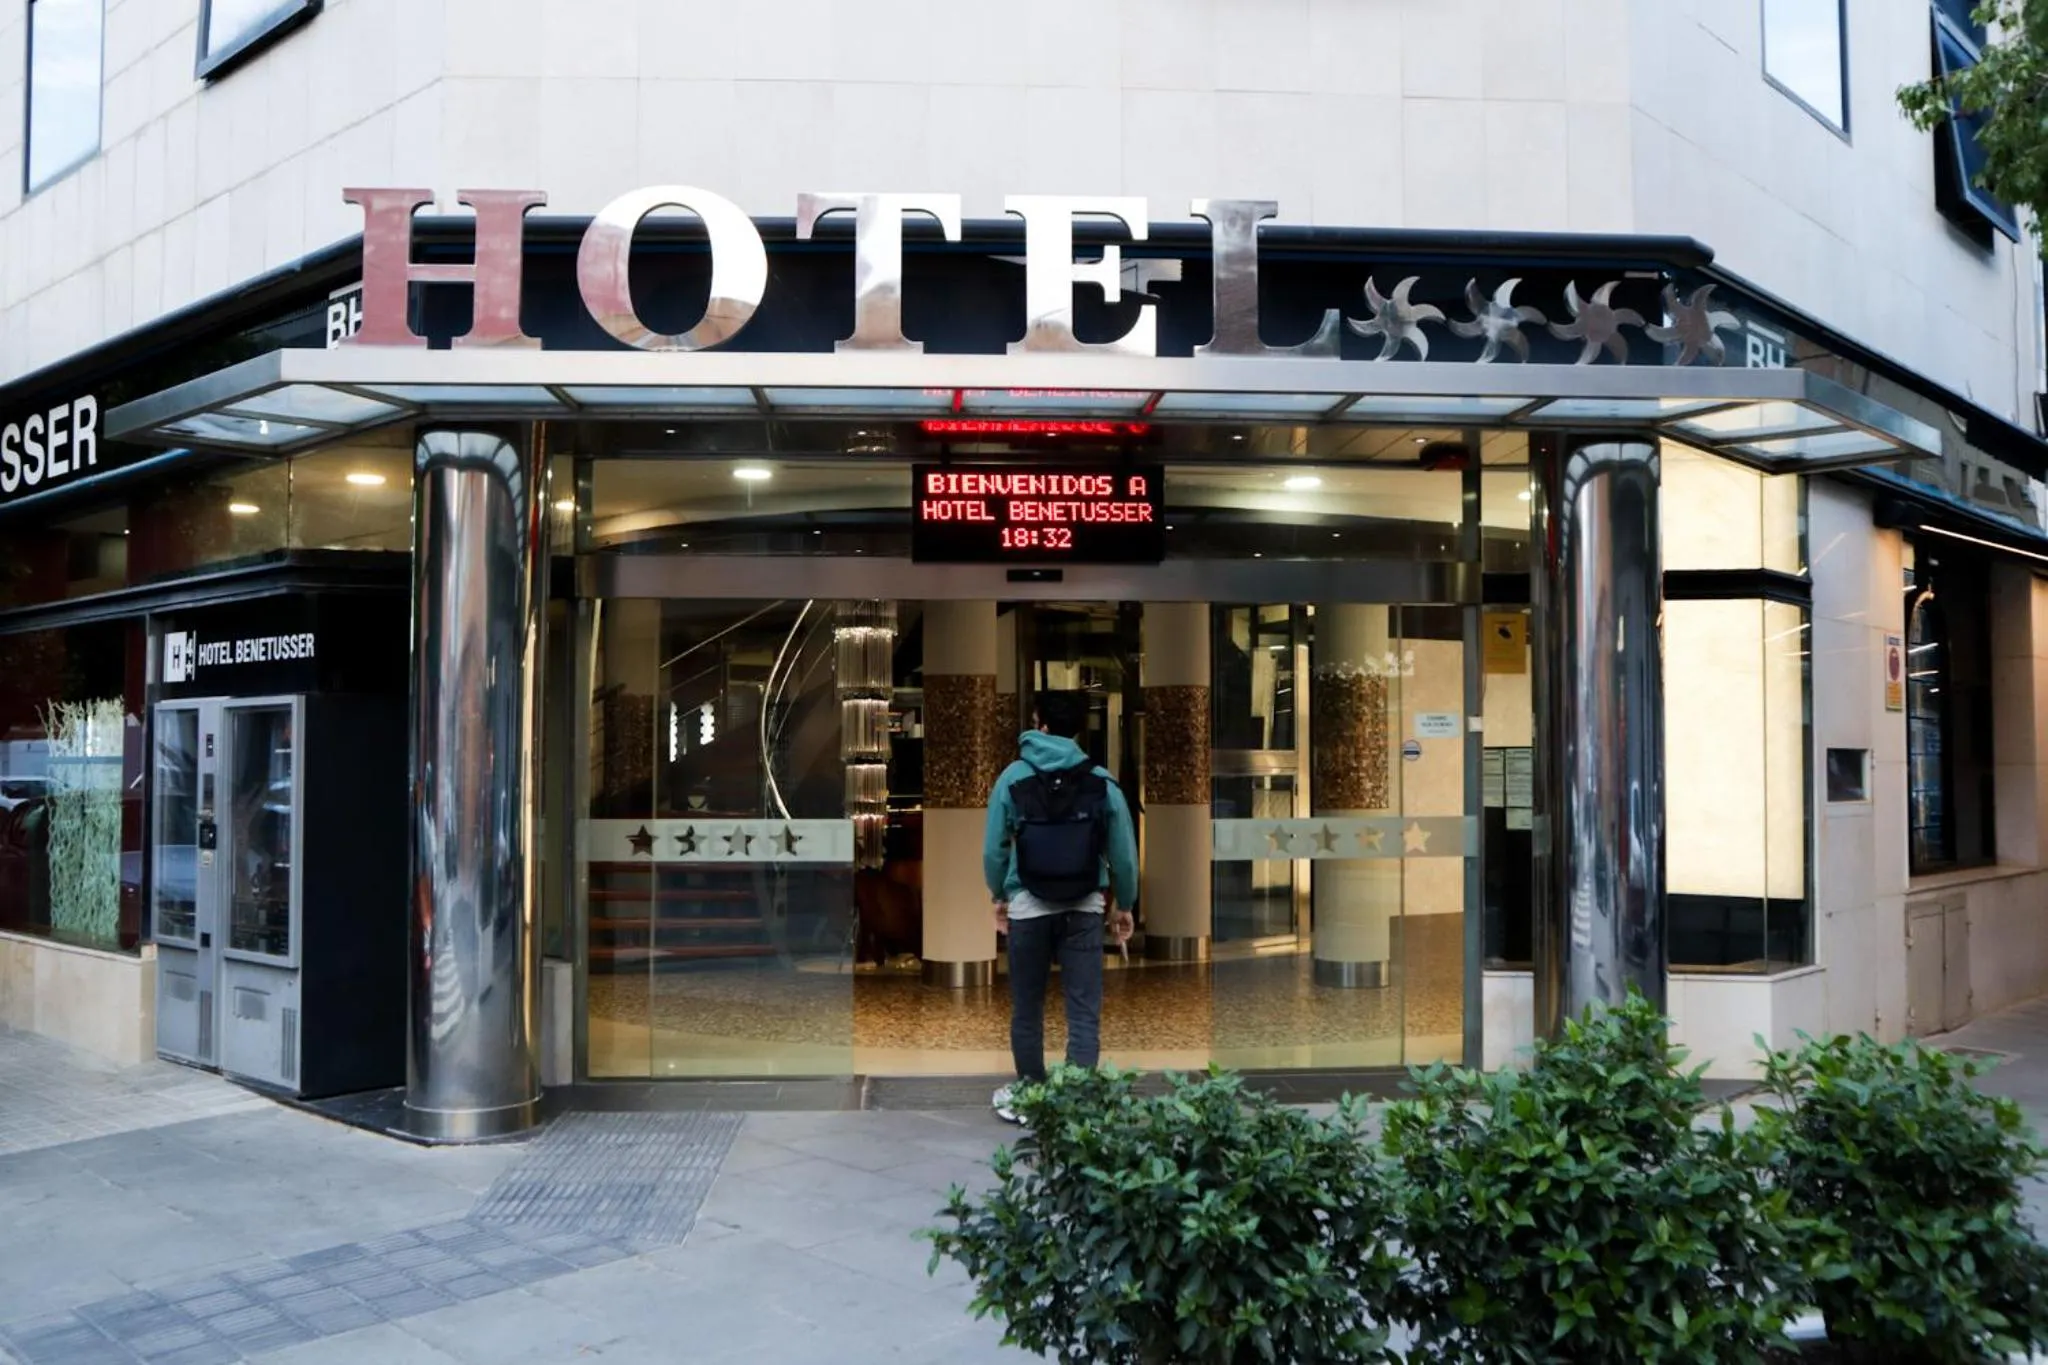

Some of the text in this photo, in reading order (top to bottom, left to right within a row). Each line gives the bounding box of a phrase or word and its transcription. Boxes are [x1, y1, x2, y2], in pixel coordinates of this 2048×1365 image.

[343, 185, 1340, 358] HOTEL
[0, 394, 98, 492] SSER
[926, 473, 1147, 496] BIENVENIDOS A
[922, 499, 1153, 522] HOTEL BENETUSSER
[1002, 527, 1073, 548] 18:32
[198, 633, 315, 666] HOTEL BENETUSSER
